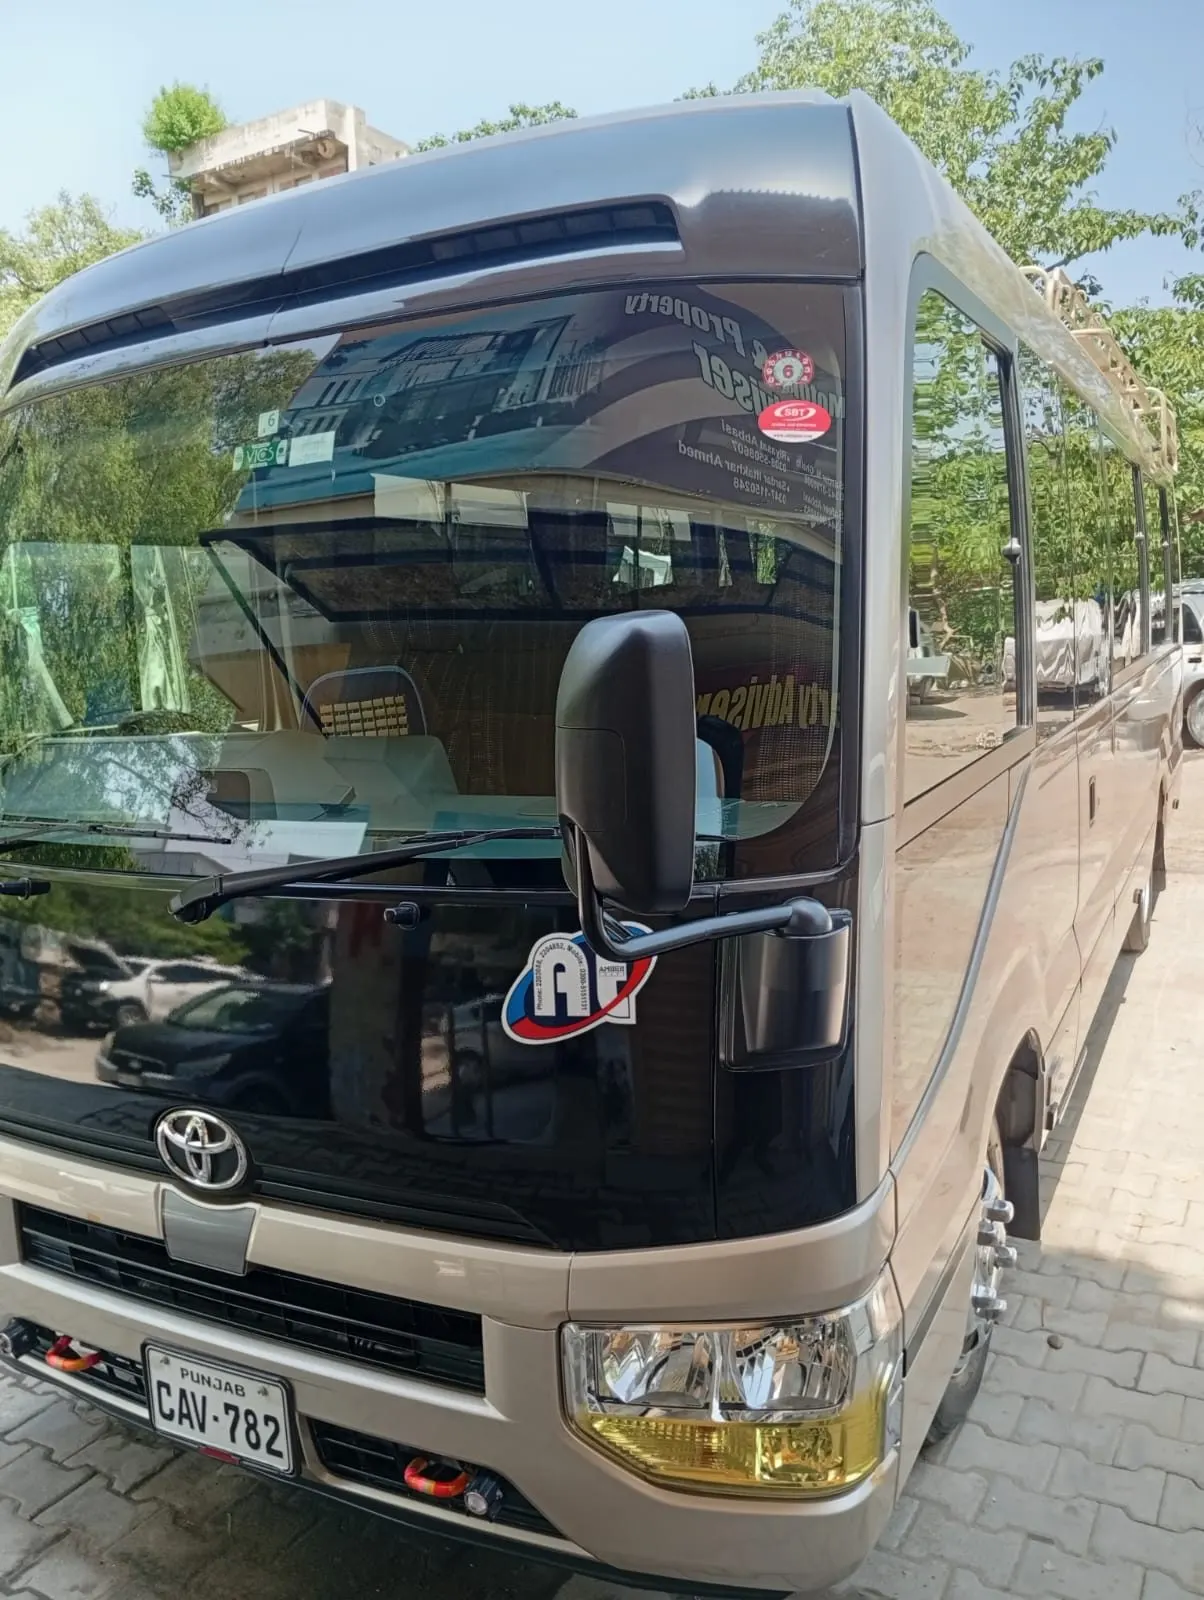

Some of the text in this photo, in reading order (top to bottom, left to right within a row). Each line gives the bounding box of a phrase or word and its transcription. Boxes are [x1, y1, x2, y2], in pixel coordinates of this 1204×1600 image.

[782, 364, 793, 379] 6
[267, 412, 276, 427] 6
[784, 408, 807, 417] SBT
[246, 446, 275, 463] VICS
[180, 1367, 245, 1397] PUNJAB
[156, 1379, 284, 1459] CAV-782
